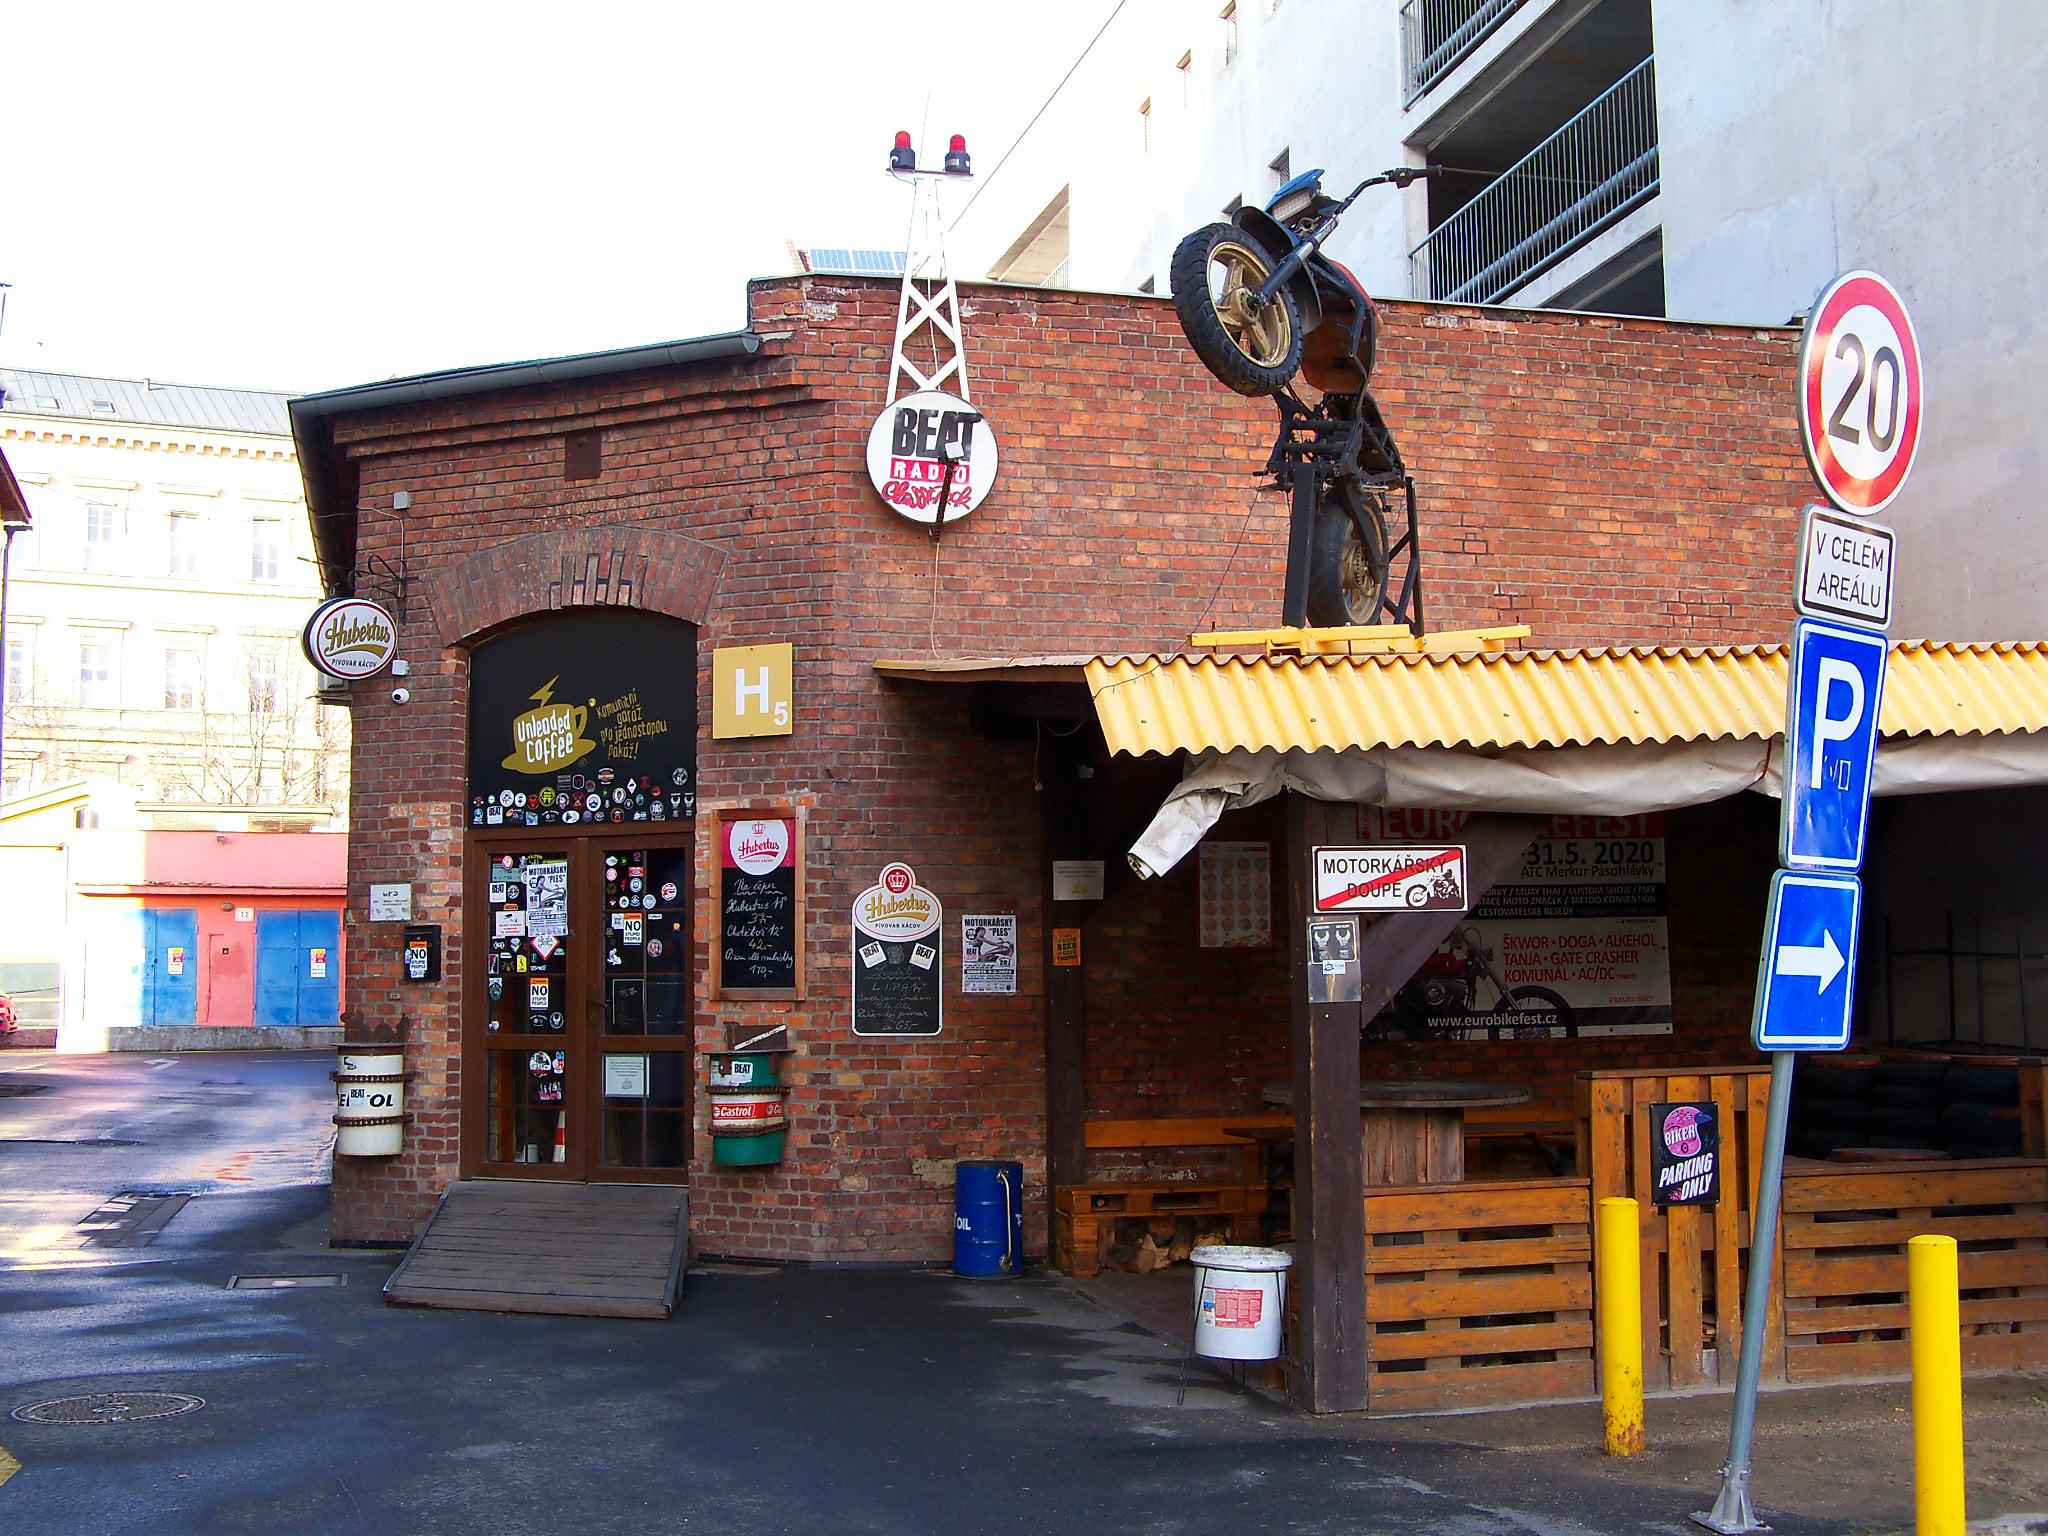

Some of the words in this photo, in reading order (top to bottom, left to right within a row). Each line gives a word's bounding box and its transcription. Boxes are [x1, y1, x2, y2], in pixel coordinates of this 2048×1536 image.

[1829, 332, 1900, 453] 20
[892, 407, 984, 463] BEAT
[893, 462, 968, 482] RADO
[1816, 531, 1826, 556] V
[1831, 536, 1884, 572] CELÉM
[1817, 572, 1881, 609] AREÁLU
[324, 612, 391, 651] Hubertus
[331, 658, 357, 667] PIVOVAR
[358, 660, 377, 668] KÁCOV
[1810, 656, 1865, 790] P
[600, 729, 613, 746] pro
[738, 838, 780, 856] Hubertus
[1526, 842, 1586, 866] 31.5.
[1594, 841, 1654, 865] 2020
[1521, 866, 1542, 878] ATC
[1546, 866, 1587, 877] Merkur
[1591, 864, 1655, 879] Pasohlávky
[1568, 886, 1603, 895] CUSTOM
[1605, 886, 1631, 895] SHOW
[726, 898, 769, 913] Hubertus
[865, 892, 931, 918] Hubertus
[1503, 897, 1529, 905] MOTO
[1571, 896, 1601, 905] TATTOO
[1604, 895, 1656, 904] CONVENTION
[624, 920, 641, 931] NO
[1503, 932, 1549, 950] ŠKWOR
[1558, 935, 1597, 949] DOGA
[1604, 934, 1658, 947] ALKEHOL
[411, 949, 426, 959] NO
[862, 943, 880, 957] BEAT
[915, 945, 934, 959] BEAT
[1504, 953, 1542, 966] TANJA
[1550, 951, 1582, 965] GATE
[1586, 950, 1639, 964] CRASHER
[1504, 966, 1569, 983] KOMUNÁL
[1578, 967, 1615, 982] AC/DC
[532, 986, 547, 996] NO
[1427, 1012, 1558, 1028] www.eurobikefest.cz
[734, 1063, 751, 1074] BEAT
[350, 1089, 365, 1098] BEAT
[720, 1106, 752, 1117] Castrol
[1664, 1123, 1697, 1146] BIKER
[1659, 1153, 1713, 1188] PARKING
[1681, 1173, 1713, 1200] ONLY
[956, 1216, 971, 1230] OIL
